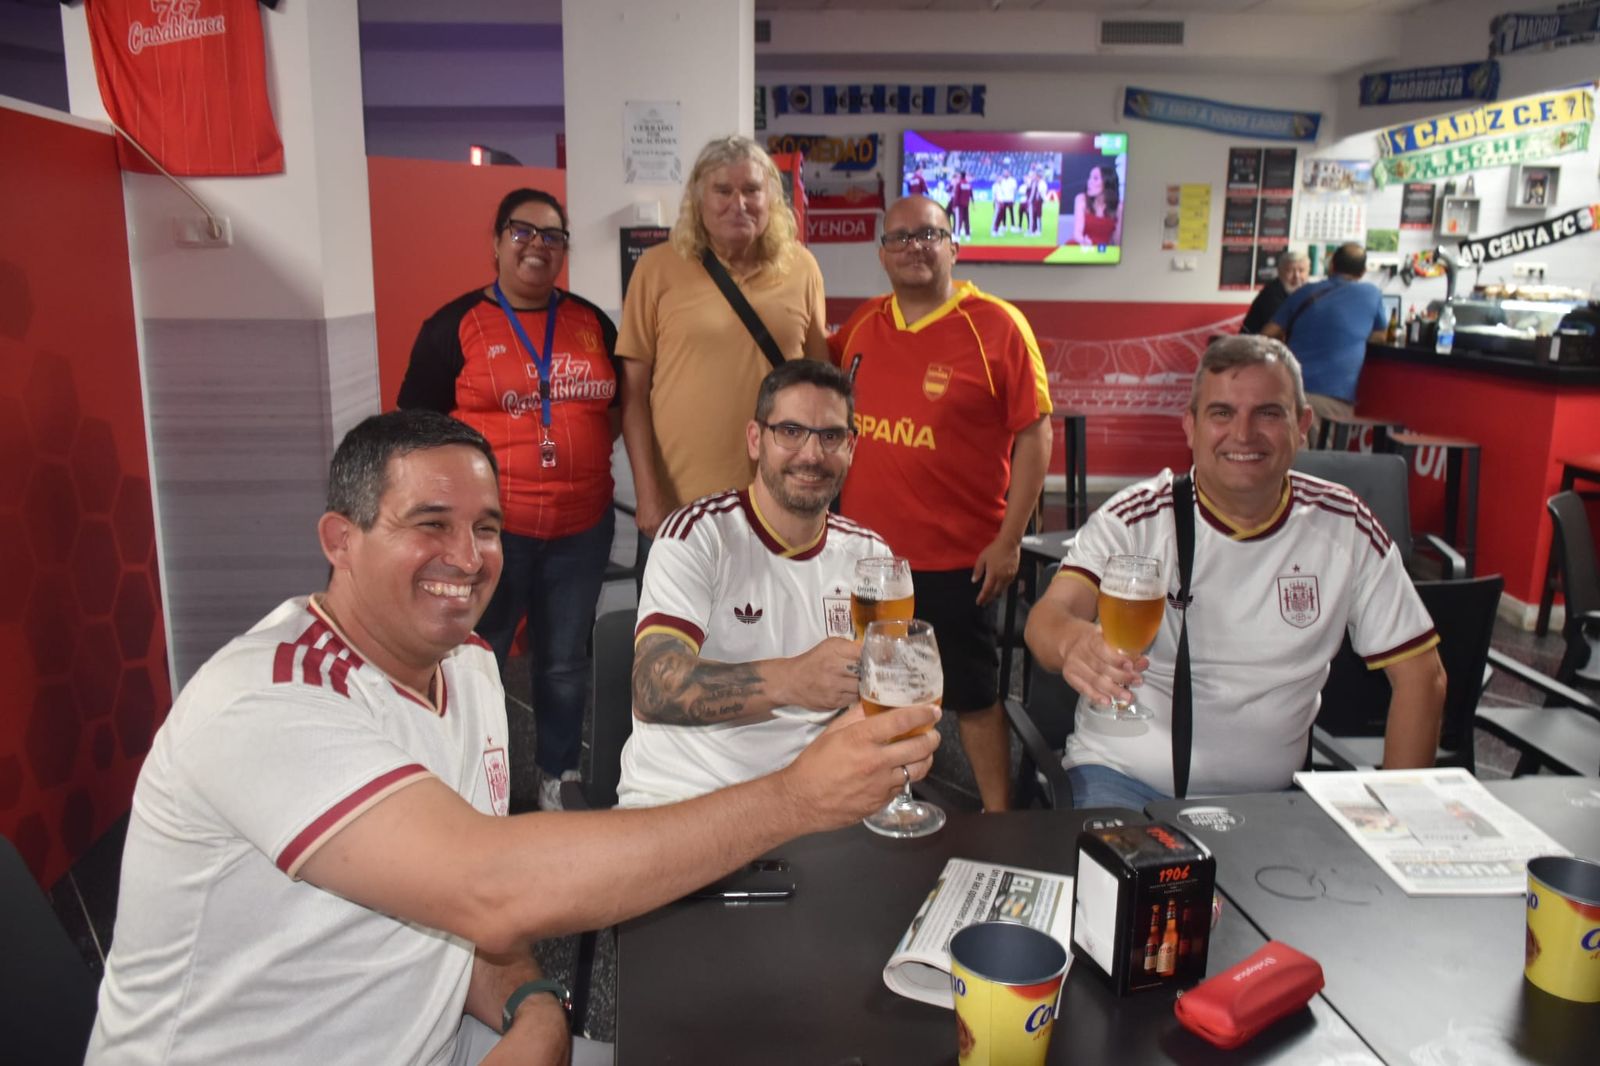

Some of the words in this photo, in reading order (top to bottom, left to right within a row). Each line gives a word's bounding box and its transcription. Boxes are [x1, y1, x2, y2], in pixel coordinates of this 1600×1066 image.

[128, 14, 225, 55] Casablanca
[1518, 15, 1560, 43] MADRID
[1389, 77, 1464, 101] MADRIDISTA
[767, 136, 874, 163] SOCIEDAD
[807, 219, 866, 236] YENDA
[1488, 226, 1550, 259] CEUTA
[1552, 214, 1576, 240] FC
[502, 376, 616, 419] Casblanca
[854, 412, 936, 450] SPAÑA
[1159, 864, 1191, 883] 1906
